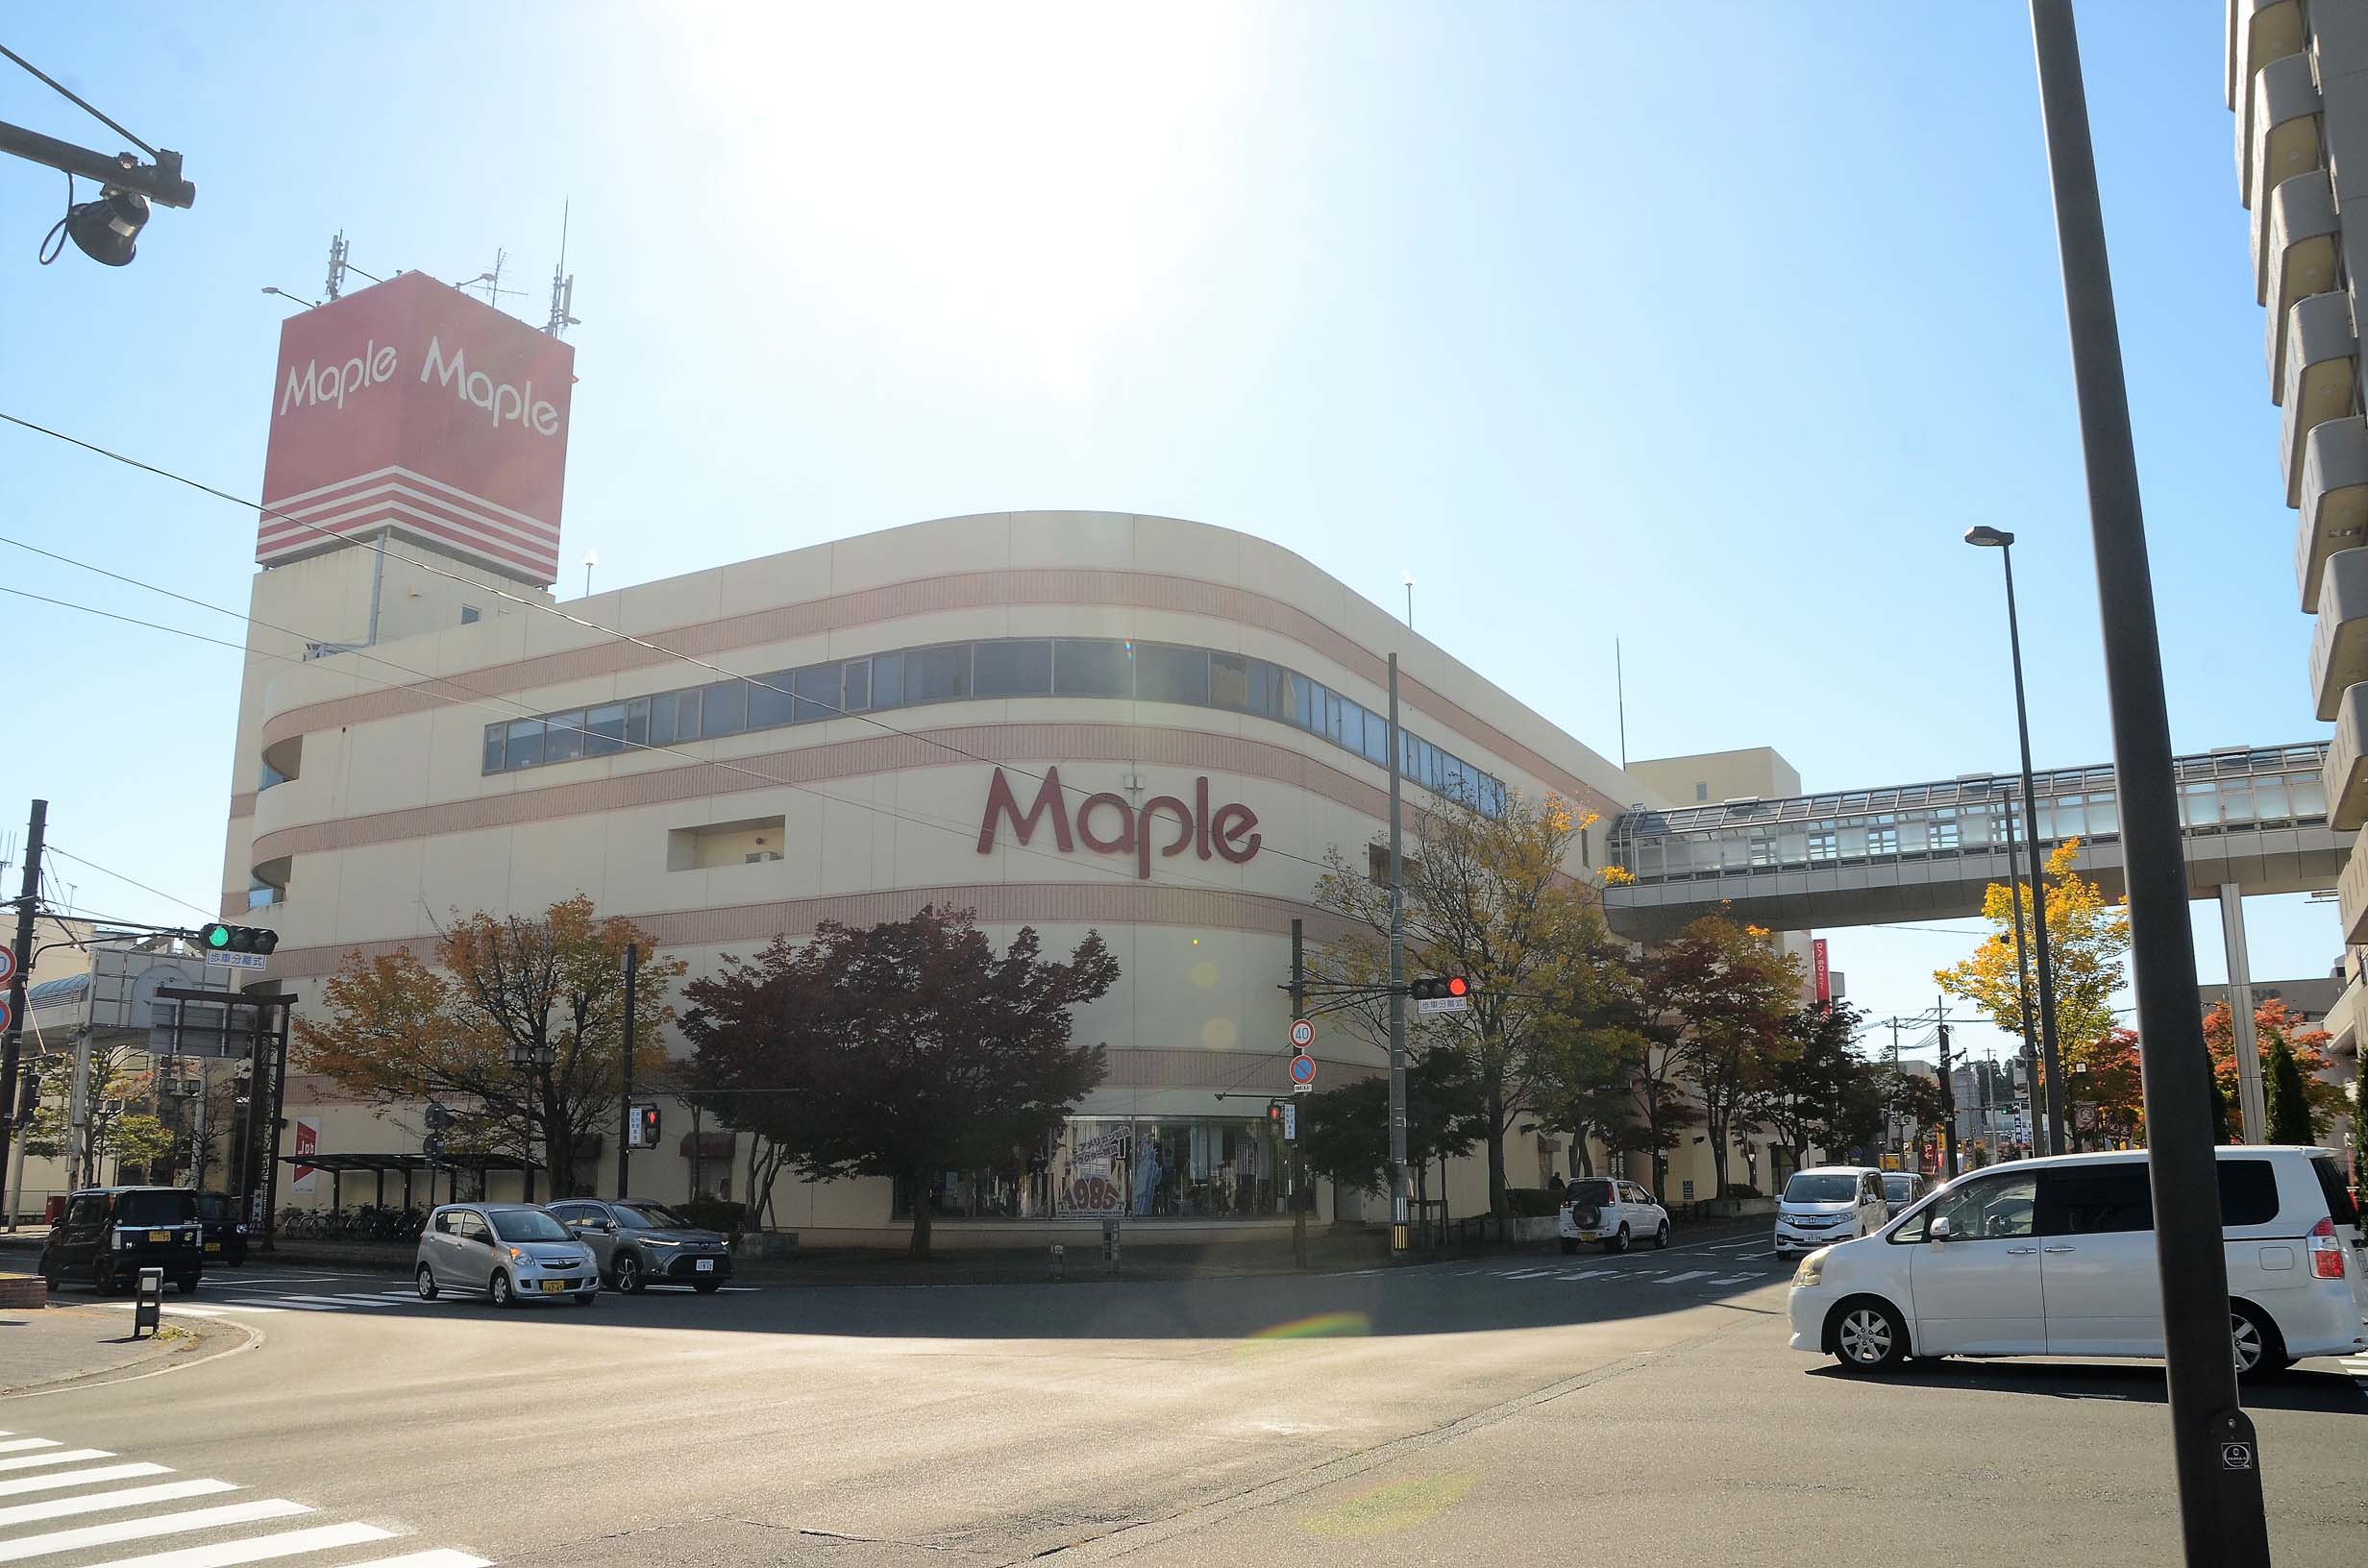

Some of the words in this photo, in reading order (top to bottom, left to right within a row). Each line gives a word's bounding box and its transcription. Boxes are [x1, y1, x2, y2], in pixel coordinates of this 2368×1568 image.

[280, 339, 397, 415] Maple
[421, 336, 558, 435] Maple
[976, 766, 1262, 879] Maple
[1295, 1027, 1309, 1040] 40
[1062, 1177, 1121, 1210] 1985
